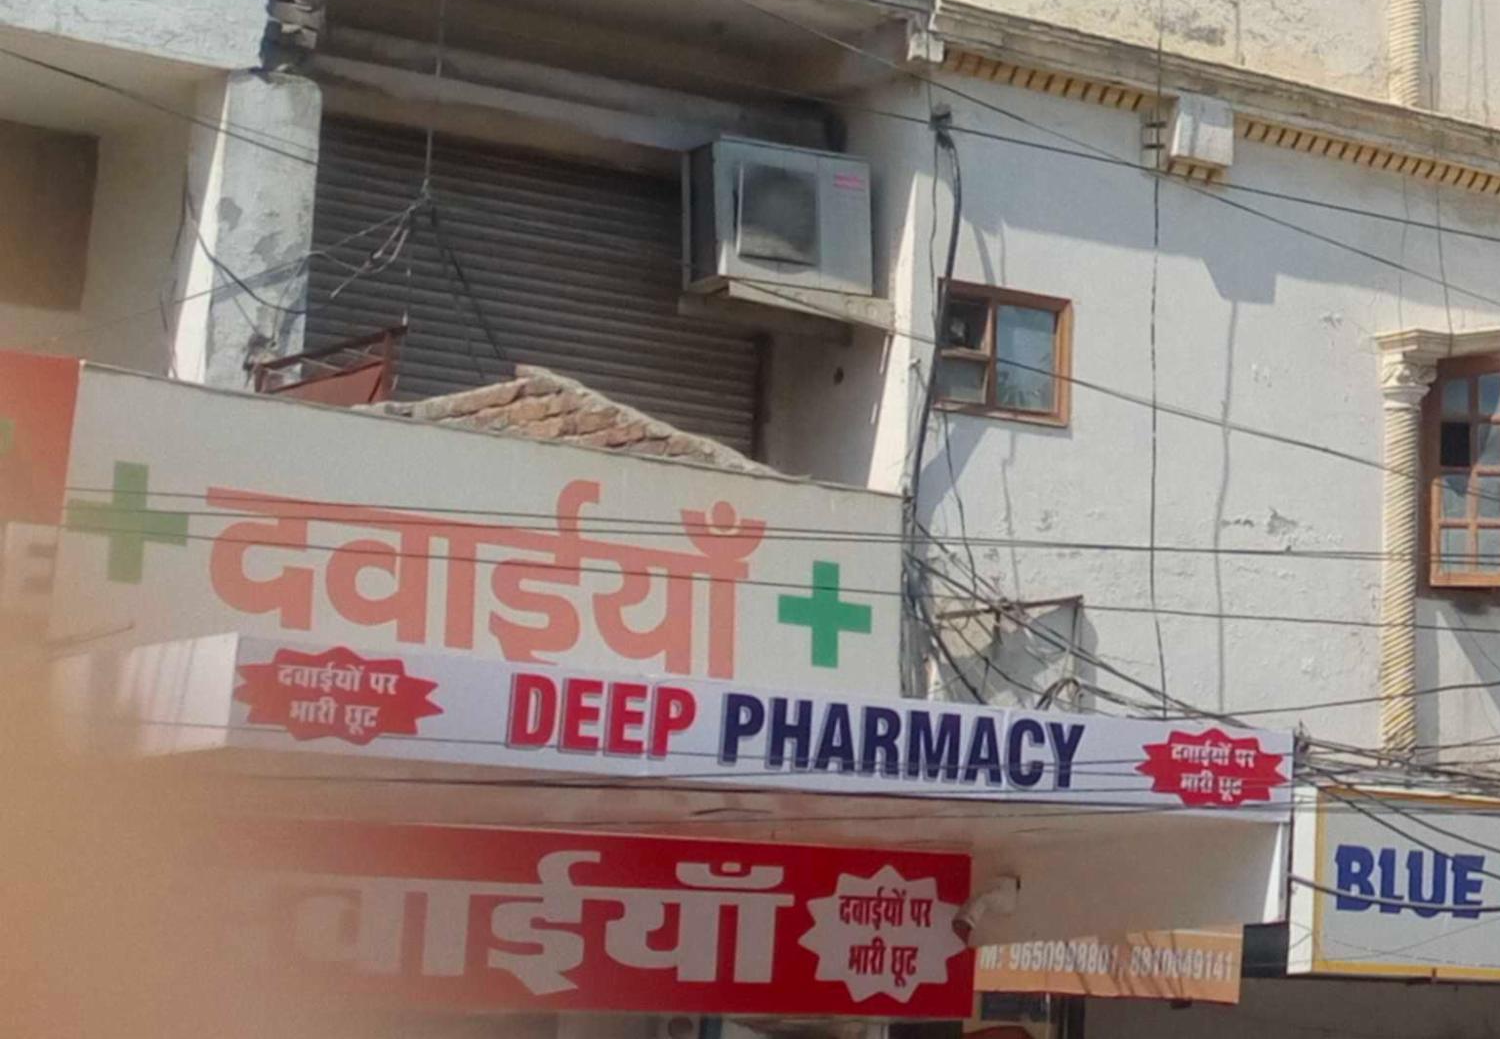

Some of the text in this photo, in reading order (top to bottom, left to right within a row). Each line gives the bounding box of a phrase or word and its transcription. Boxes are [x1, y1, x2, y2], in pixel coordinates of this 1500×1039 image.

[369, 673, 398, 695] पर
[290, 697, 380, 735] भारी छूट
[506, 672, 1085, 790] DEEP PHARMACY
[1334, 843, 1486, 917] BLUE
[838, 885, 934, 930] दवाईयों पर
[848, 935, 919, 988] भारी छूट
[980, 945, 1002, 970] M:
